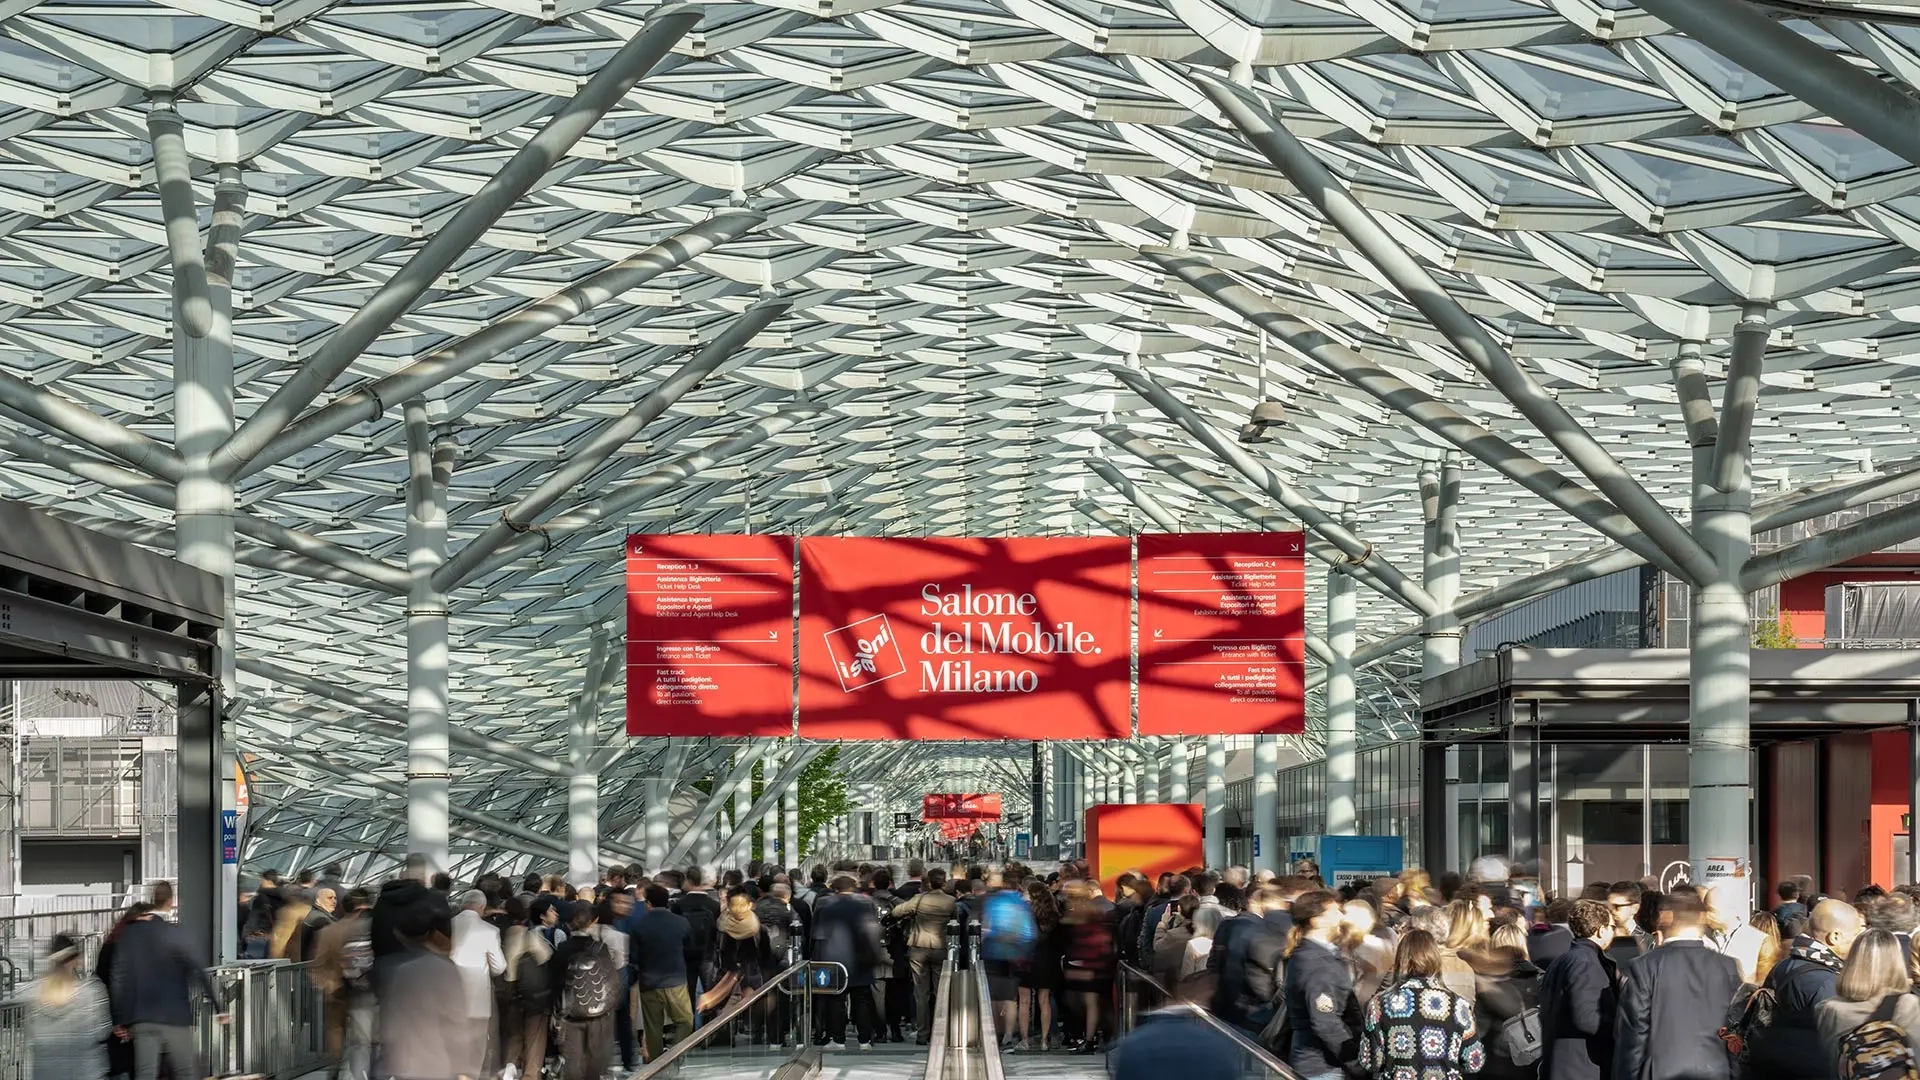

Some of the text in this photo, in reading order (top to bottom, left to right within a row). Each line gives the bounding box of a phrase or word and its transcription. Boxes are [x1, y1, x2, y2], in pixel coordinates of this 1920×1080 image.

[921, 583, 1037, 616] Salone
[920, 622, 1101, 654] del Mobile.
[919, 660, 1038, 693] Milano
